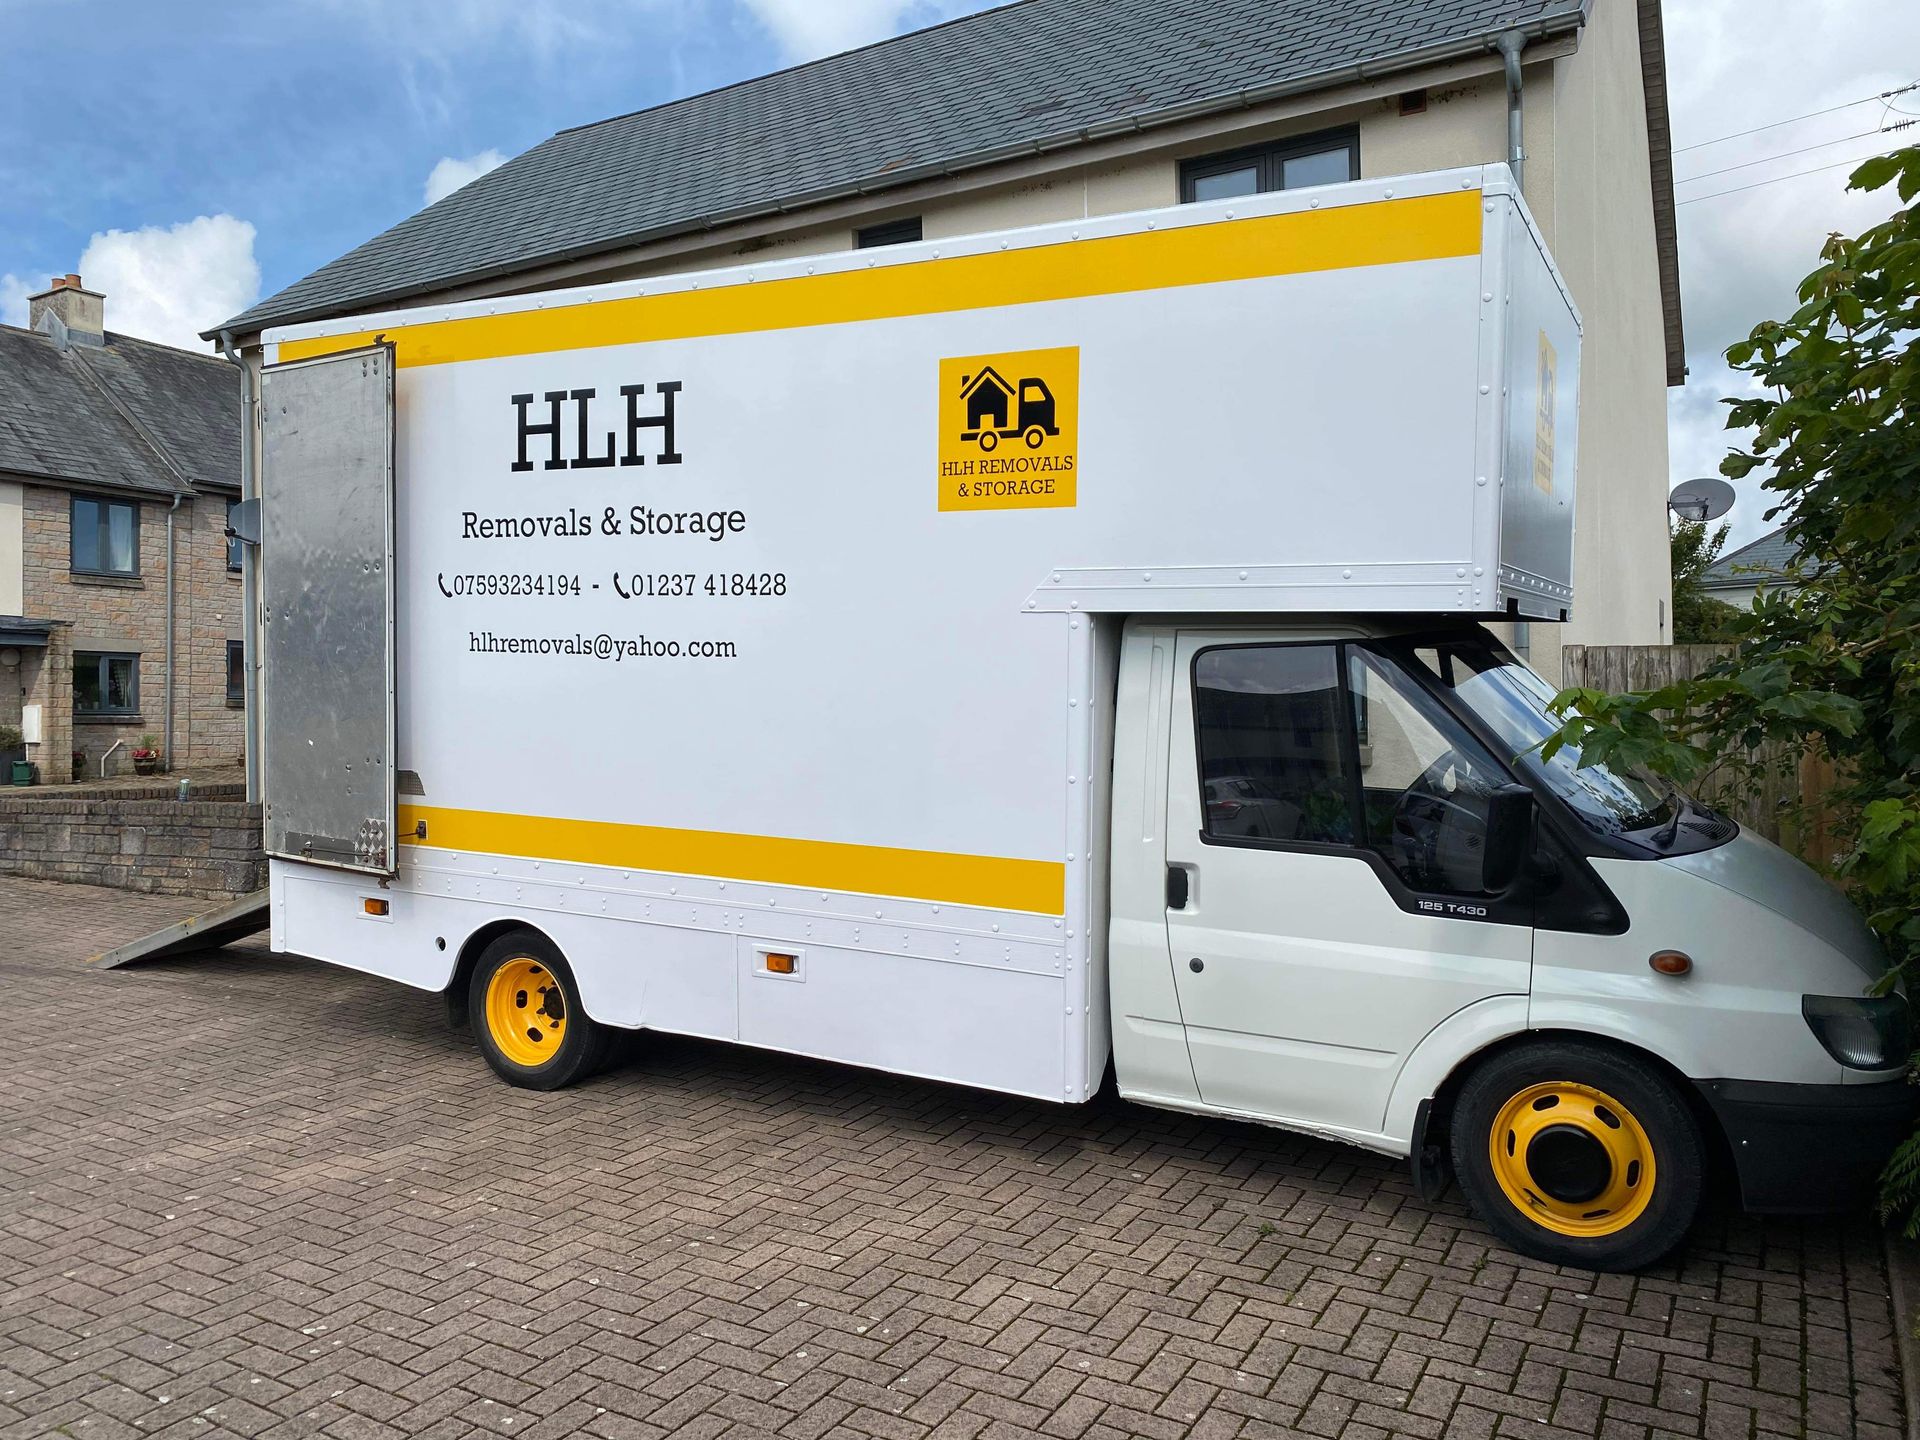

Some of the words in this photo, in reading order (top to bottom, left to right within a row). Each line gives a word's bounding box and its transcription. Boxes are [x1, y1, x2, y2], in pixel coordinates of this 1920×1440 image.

[511, 380, 683, 472] HLH
[942, 460, 974, 476] HLH
[979, 455, 1073, 474] REMOVALS
[958, 483, 969, 497] &
[973, 479, 1055, 496] STORAGE
[462, 508, 592, 539] Removals
[600, 507, 621, 536] &
[630, 505, 746, 542] Storage
[453, 574, 581, 596] 07593234194
[631, 574, 696, 596] 01237
[704, 573, 787, 596] 418428
[469, 632, 737, 662] hlhremovals@yahoo.com
[1418, 900, 1443, 911] 125
[1447, 903, 1487, 916] T430
